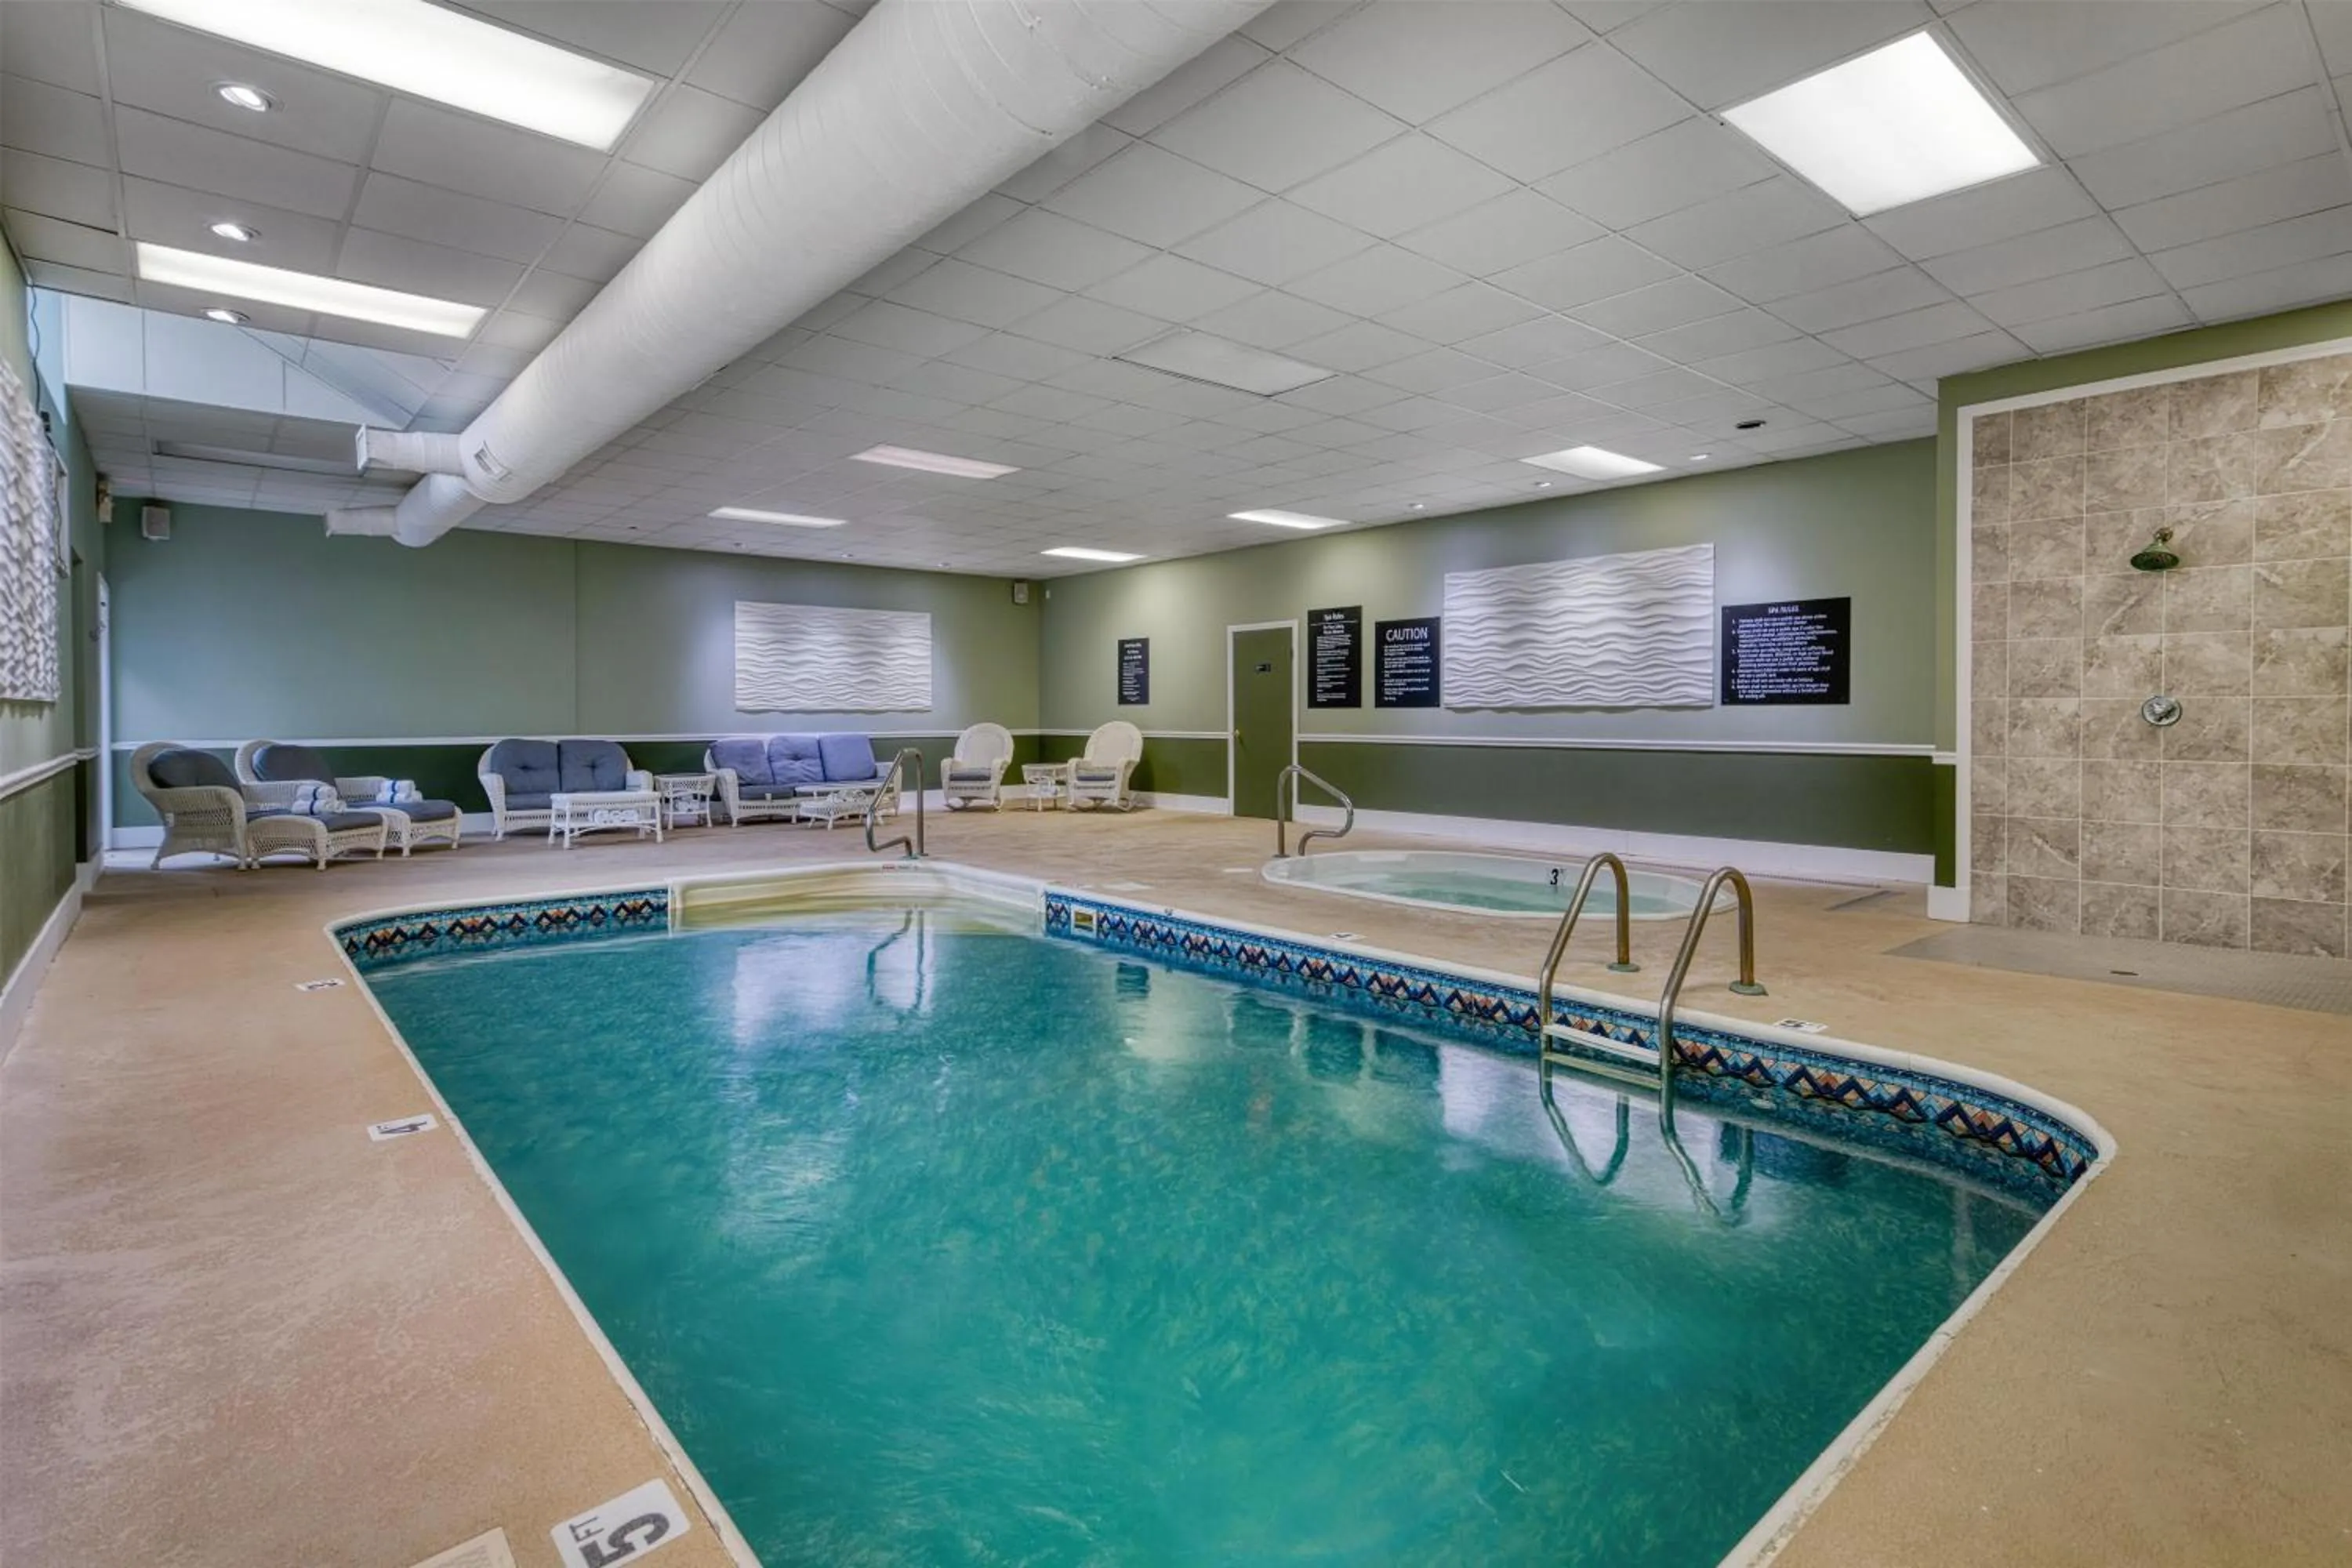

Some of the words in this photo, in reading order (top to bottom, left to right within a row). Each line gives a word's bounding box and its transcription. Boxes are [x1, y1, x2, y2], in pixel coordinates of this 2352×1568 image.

[1385, 627, 1428, 642] CAUTION
[1550, 868, 1559, 885] 3
[569, 1516, 605, 1542] FT
[579, 1512, 670, 1568] 5
